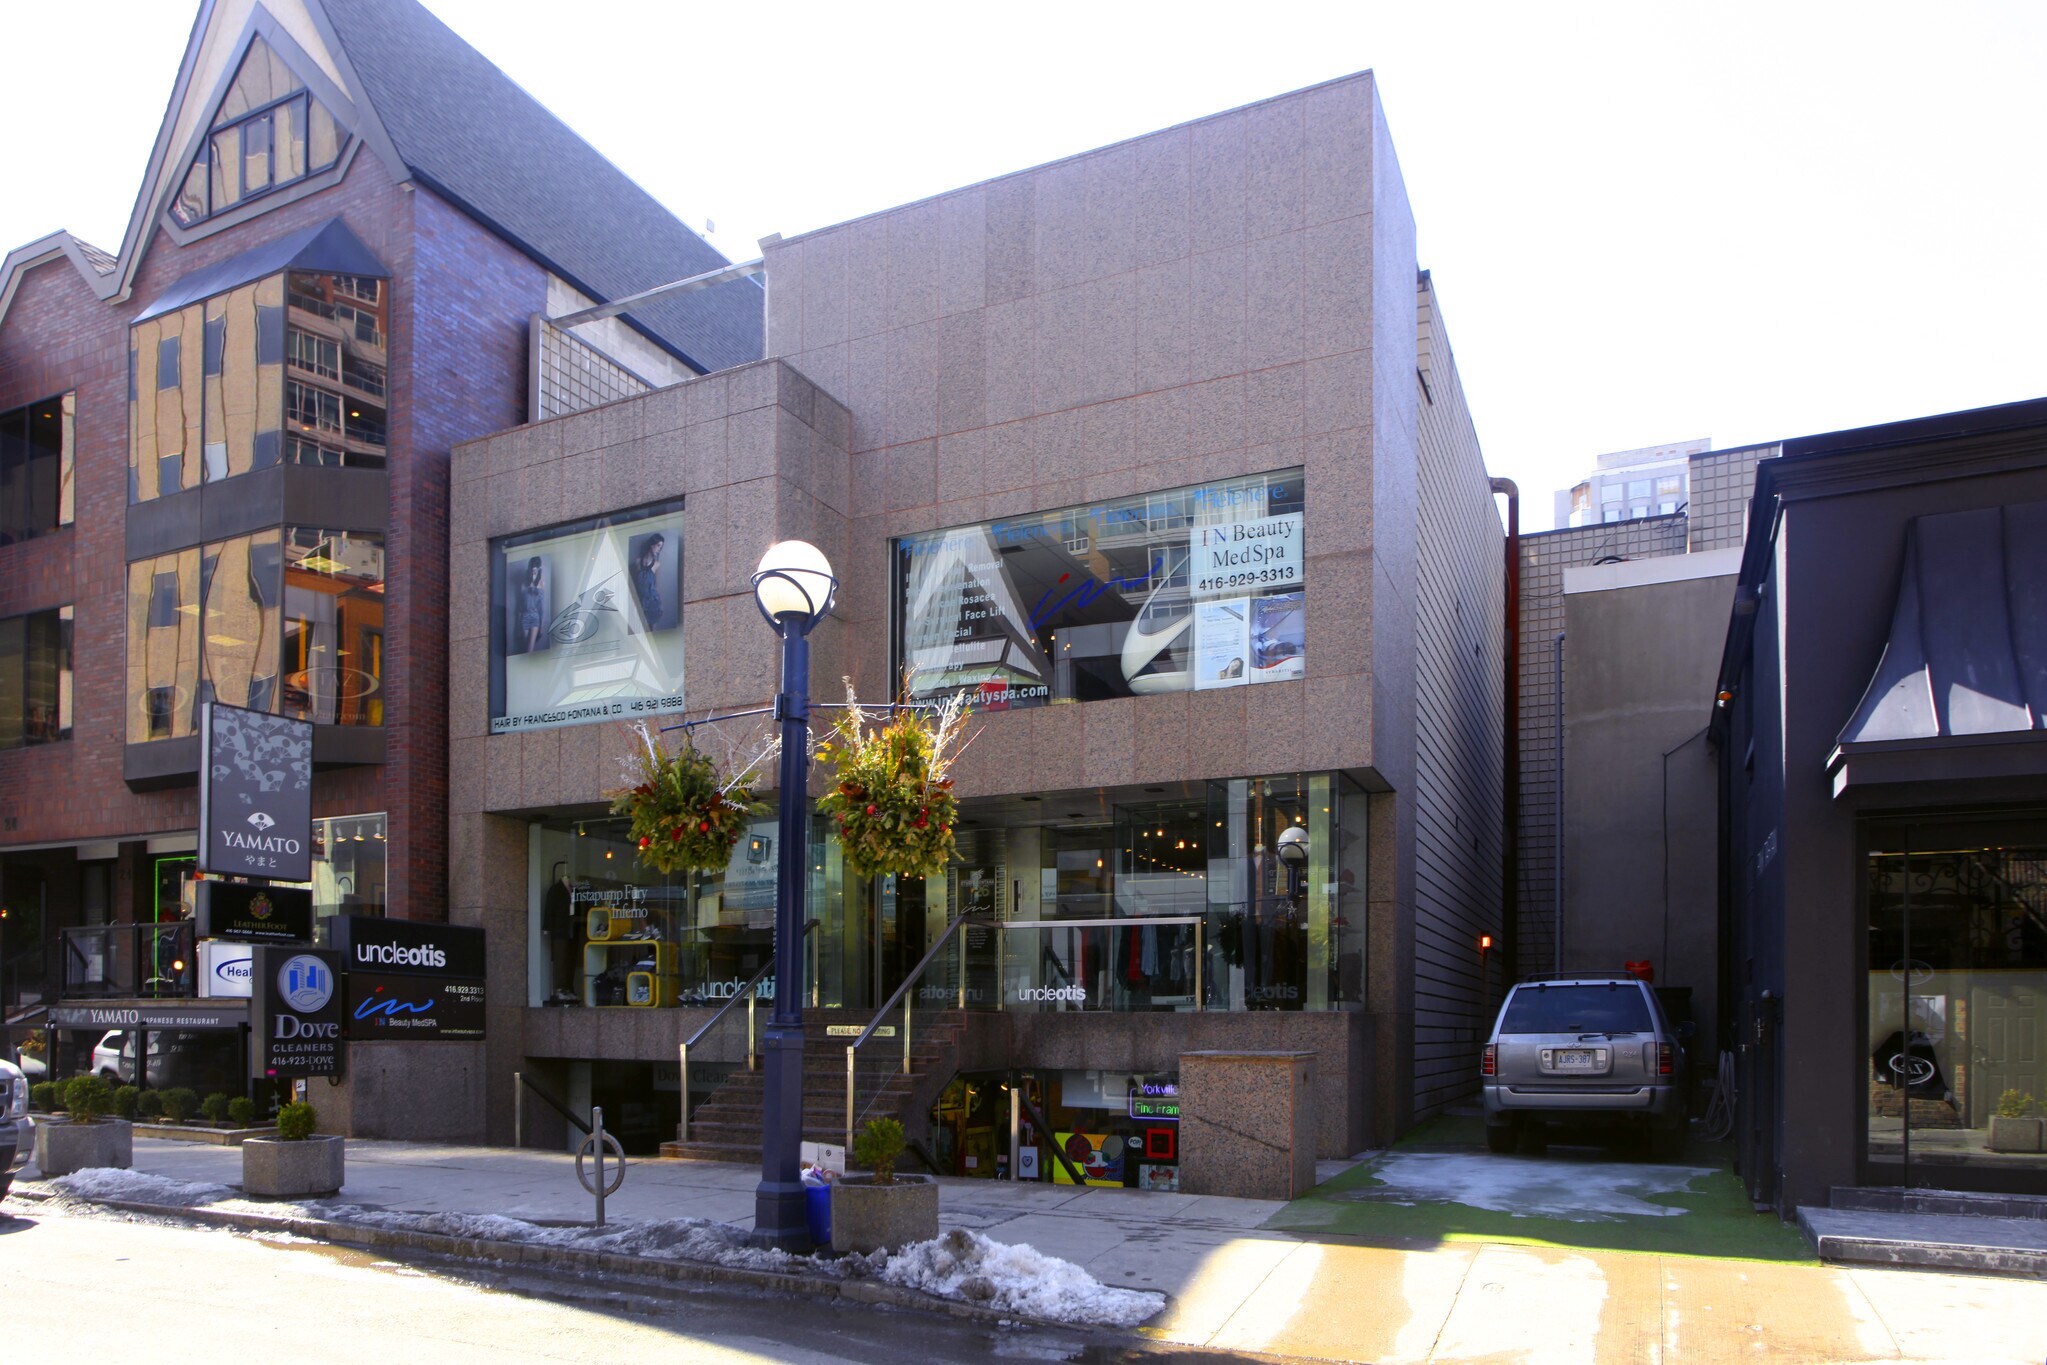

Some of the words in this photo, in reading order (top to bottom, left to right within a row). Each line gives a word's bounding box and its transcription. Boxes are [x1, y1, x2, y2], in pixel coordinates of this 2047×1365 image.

[1233, 520, 1295, 542] Beauty
[1213, 544, 1285, 568] MedSpa
[968, 558, 1004, 573] Removal
[1199, 566, 1294, 591] 416-929-3313
[965, 610, 987, 621] Face
[990, 606, 1006, 617] Lift
[494, 718, 511, 729] HAIR
[513, 716, 523, 727] BY
[524, 712, 566, 725] FRANCESCO
[567, 707, 602, 720] FONTANA
[603, 706, 609, 716] &
[612, 703, 624, 715] CO.
[631, 701, 644, 712] 416
[646, 698, 659, 710] 921
[222, 830, 300, 854] YAMATO
[244, 855, 277, 868] やまと
[571, 887, 624, 905] Instapump
[624, 884, 648, 904] Fury
[357, 941, 446, 967] uncleotis
[1018, 984, 1086, 1001] uncleotis
[90, 1009, 139, 1024] YAMATO
[176, 1017, 220, 1025] RESTAURANT
[389, 1018, 411, 1028] Beauty
[272, 1043, 334, 1053] CLEANERS
[657, 1069, 682, 1082] Dov
[1140, 1083, 1178, 1095] Yorkville
[1135, 1102, 1154, 1114] Fine
